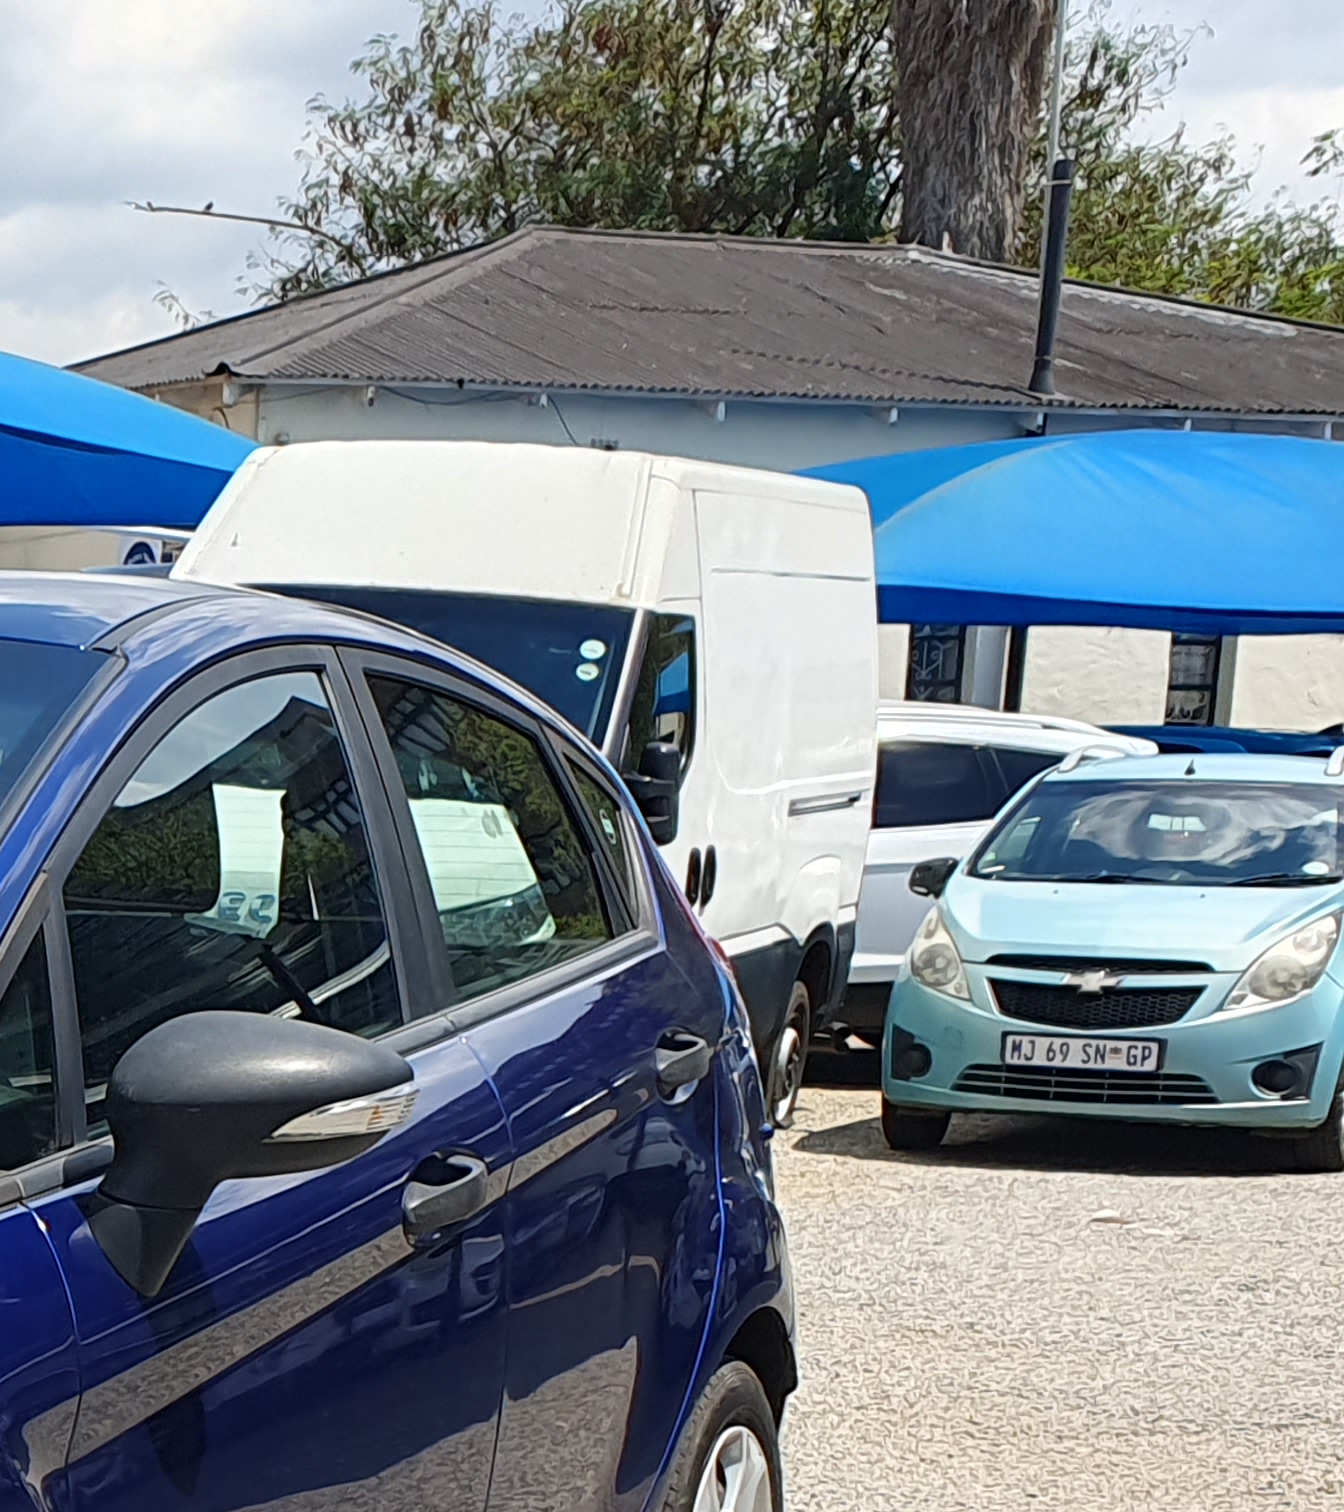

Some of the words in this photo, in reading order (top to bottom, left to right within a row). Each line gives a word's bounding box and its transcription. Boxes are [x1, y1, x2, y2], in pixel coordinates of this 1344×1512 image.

[1010, 1039, 1036, 1062] MJ
[1046, 1041, 1071, 1063] 69
[1081, 1043, 1107, 1065] SN
[1126, 1045, 1153, 1067] GP
